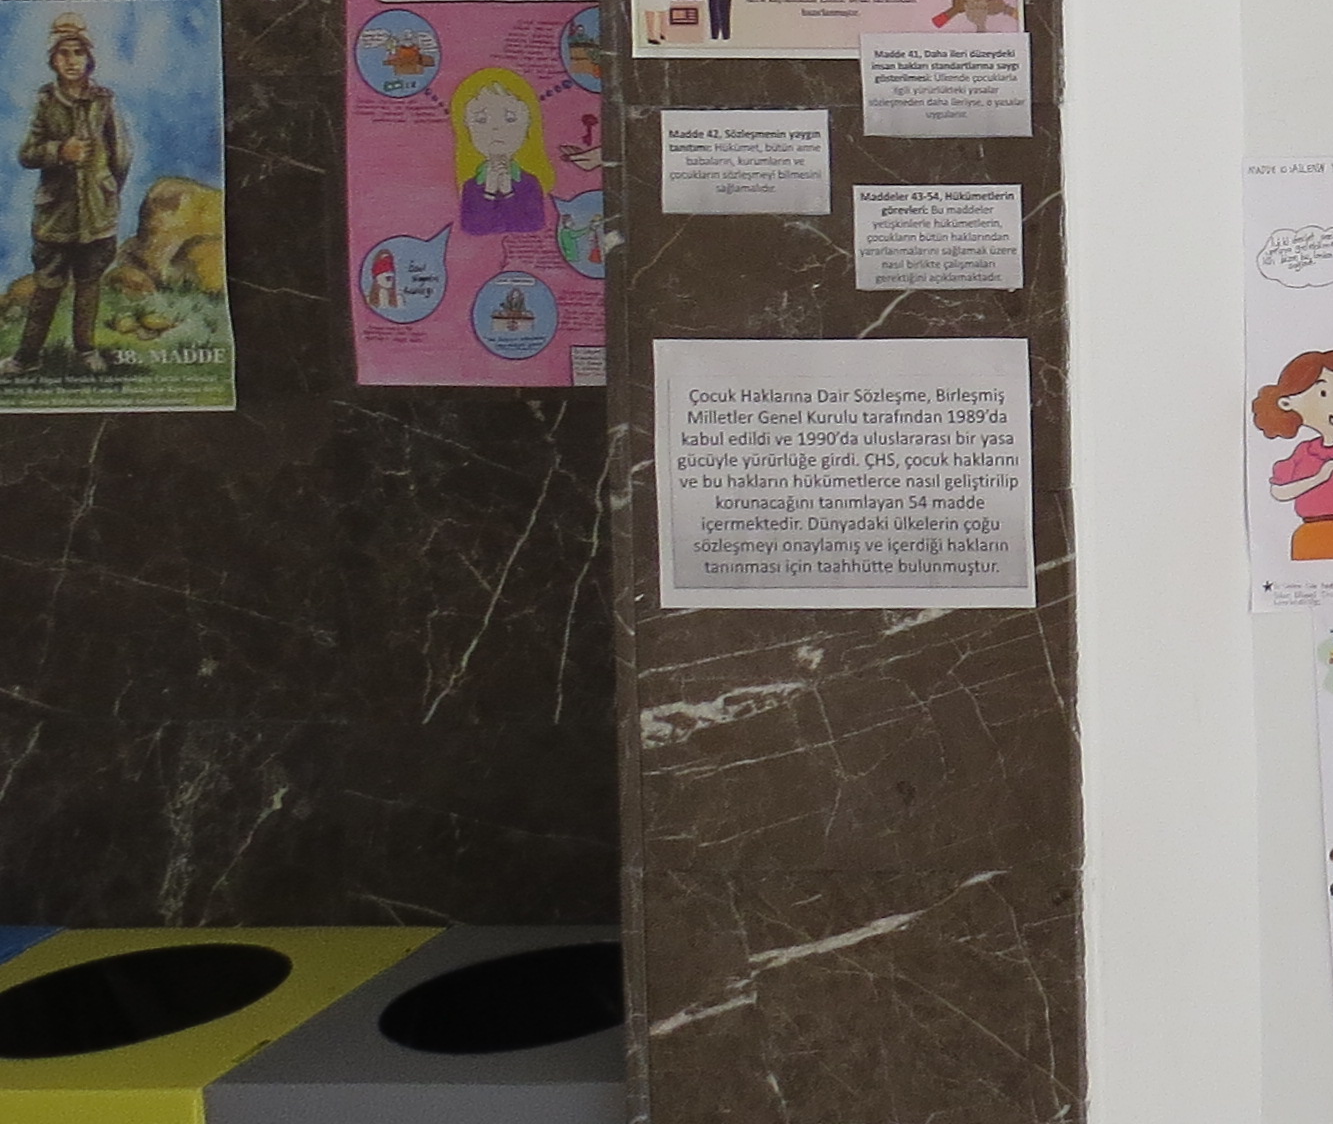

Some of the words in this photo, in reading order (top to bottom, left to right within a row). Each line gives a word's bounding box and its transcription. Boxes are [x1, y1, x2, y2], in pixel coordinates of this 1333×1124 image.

[112, 349, 144, 364] 38.
[149, 348, 227, 365] MADDE
[688, 388, 737, 407] Çocuk
[740, 388, 813, 404] Haklarına
[817, 389, 851, 404] Dair
[853, 387, 931, 406] Sözleşme,
[935, 387, 1005, 406] Birleşmiş
[687, 409, 754, 425] Milletler
[757, 409, 803, 425] Genel
[806, 409, 859, 425] Kurulu
[861, 408, 943, 425] tarafından
[681, 431, 724, 447] kabul
[727, 431, 771, 447] edildi
[774, 435, 793, 447] ve
[863, 429, 951, 446] uluslararası
[955, 429, 977, 446] bir
[980, 433, 1015, 449] yasa
[677, 452, 739, 471] gücüyle
[741, 452, 817, 471] yürürlüğe
[821, 451, 861, 471] girdi.
[864, 452, 901, 471] ÇHS,
[903, 451, 950, 471] çocuk
[953, 451, 1019, 467] haklarını
[679, 477, 699, 489] ve
[702, 473, 723, 489] bu
[727, 473, 789, 489] hakların
[793, 473, 901, 489] hükümetlerce
[905, 473, 941, 489] nasıl
[944, 473, 1019, 492] geliştirilip
[715, 495, 815, 513] korunacağını
[817, 493, 905, 513] tanımlayan
[908, 495, 928, 510] 54
[931, 494, 985, 510] madde
[701, 515, 803, 535] içermektedir.
[807, 515, 889, 535] Dünyadaki
[893, 515, 959, 531] ülkelerin
[963, 516, 1001, 535] çoğu
[693, 537, 779, 557] sözleşmeyi
[781, 537, 861, 556] onaylamış
[864, 540, 883, 553] ve
[887, 537, 943, 556] içerdiği
[946, 536, 1009, 553] hakların
[704, 561, 781, 574] tanınması
[785, 559, 813, 577] için
[816, 557, 894, 574] taahhütte
[897, 557, 1000, 577] bulunmuştur.
